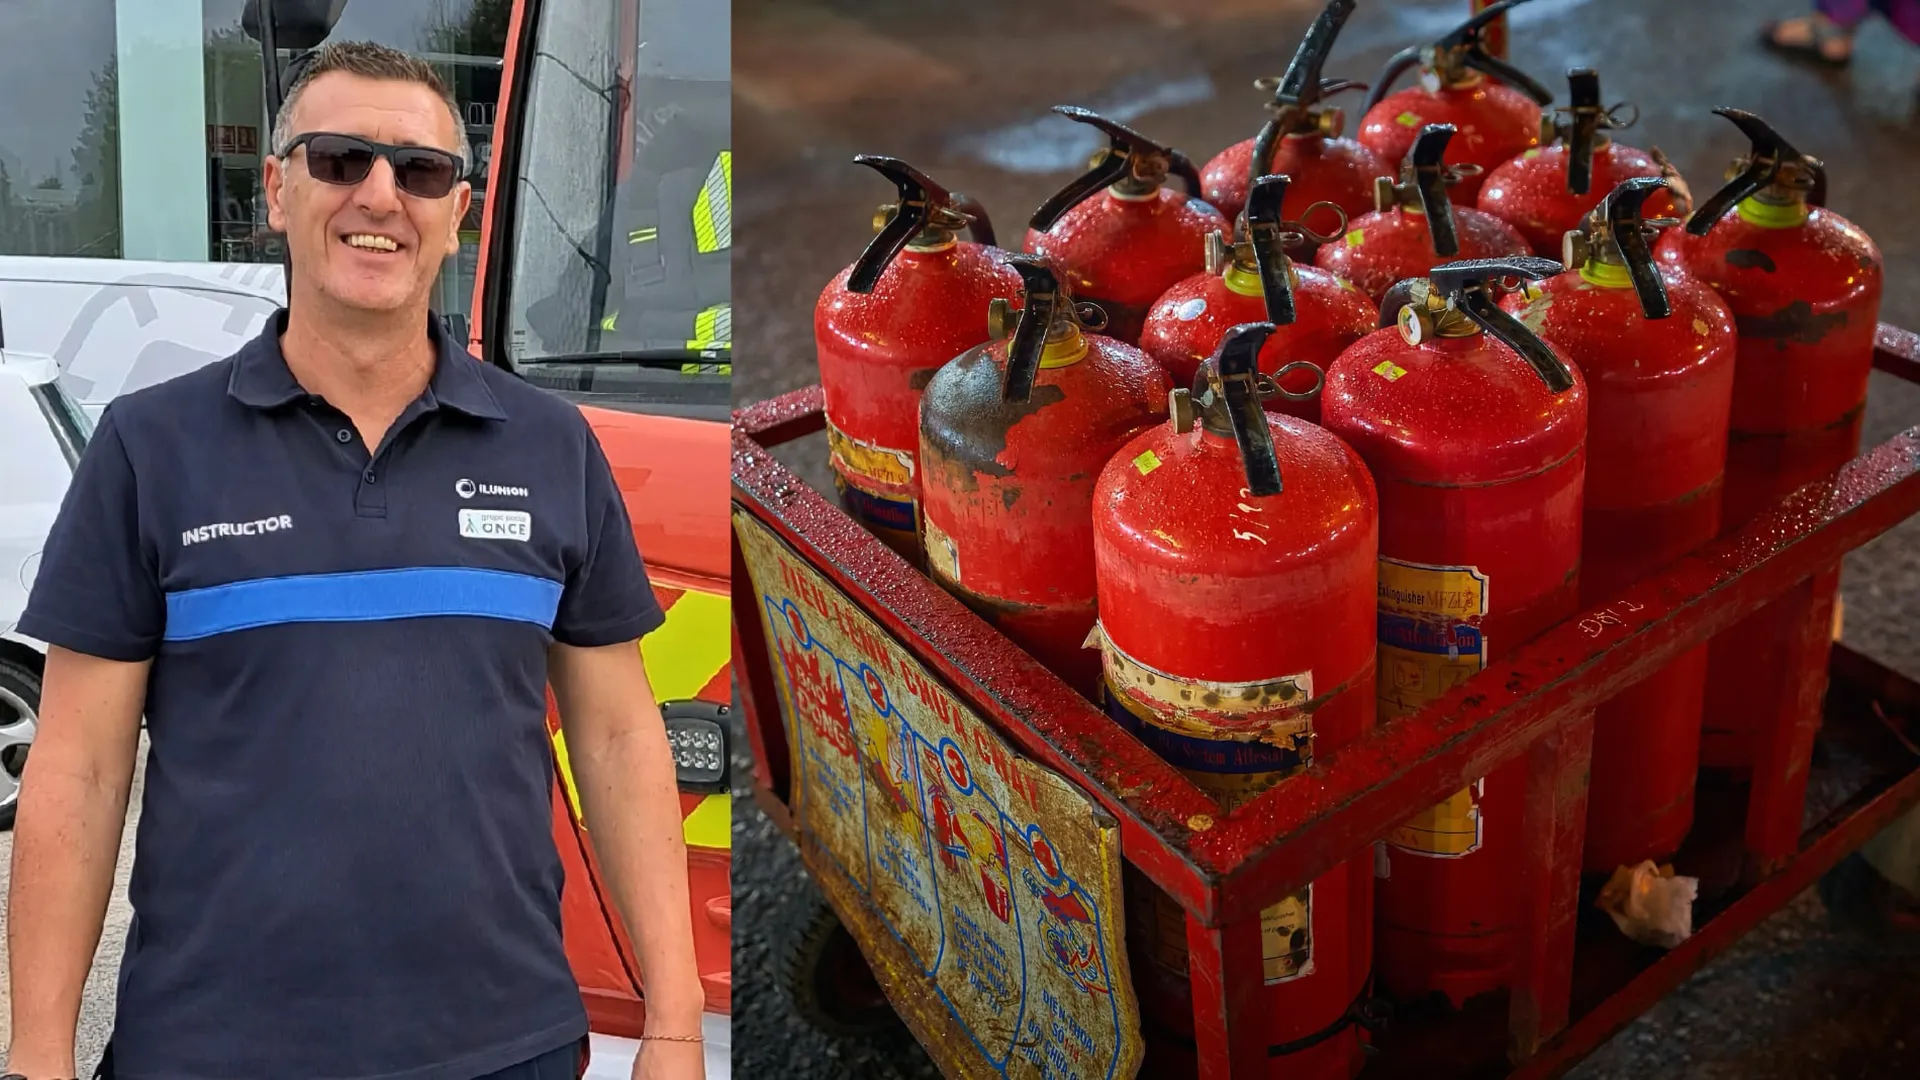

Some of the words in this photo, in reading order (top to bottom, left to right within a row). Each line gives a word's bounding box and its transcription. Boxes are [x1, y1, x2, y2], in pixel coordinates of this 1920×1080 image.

[479, 483, 529, 498] ILUNION
[182, 514, 293, 547] INSTRUCTOR
[482, 523, 527, 536] ONCE
[864, 669, 887, 711] 2
[946, 747, 969, 788] 3
